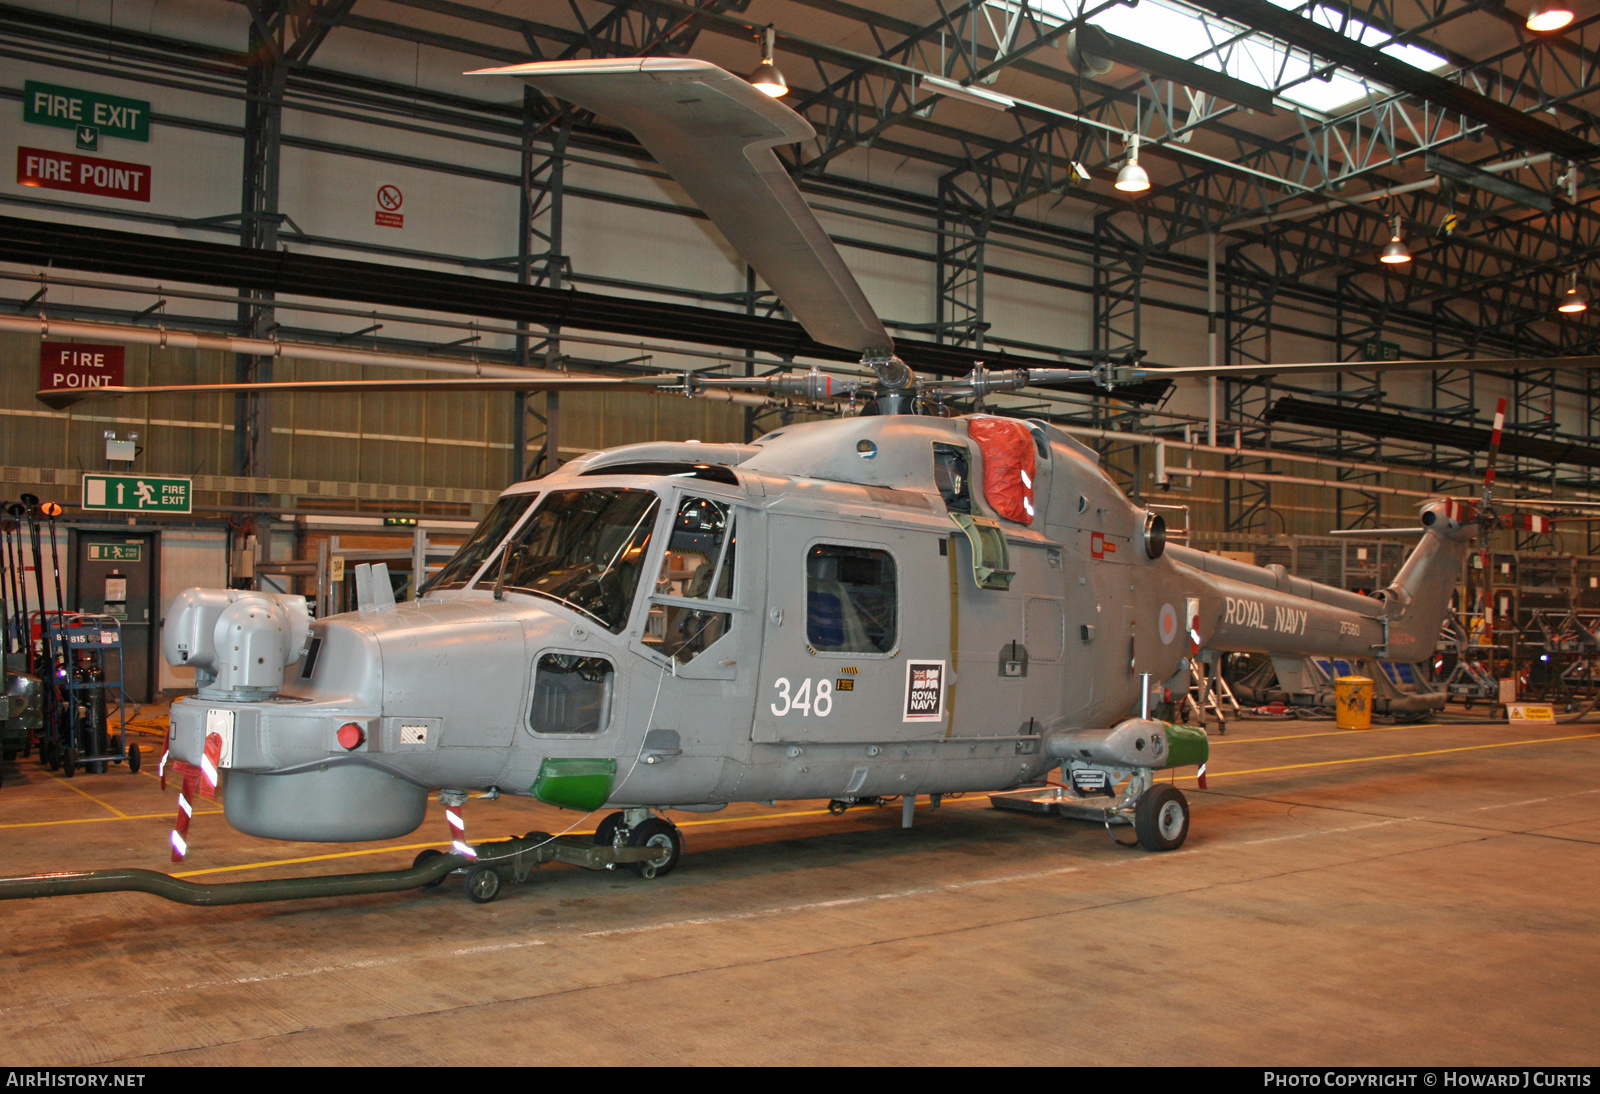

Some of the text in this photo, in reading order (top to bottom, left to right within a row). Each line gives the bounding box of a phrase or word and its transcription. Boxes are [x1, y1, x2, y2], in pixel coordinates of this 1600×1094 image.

[34, 92, 141, 130] FIRE EXIT
[26, 155, 144, 192] FIRE POINT
[60, 350, 104, 368] FIRE
[53, 373, 112, 388] POINT
[162, 485, 186, 495] FIRE
[161, 495, 186, 505] EXIT
[1224, 596, 1308, 636] ROYAL NAVY
[1339, 620, 1361, 637] ZF560
[70, 635, 86, 643] 815
[770, 677, 833, 717] 348
[911, 690, 937, 701] ROYAL
[910, 700, 936, 710] NAVY
